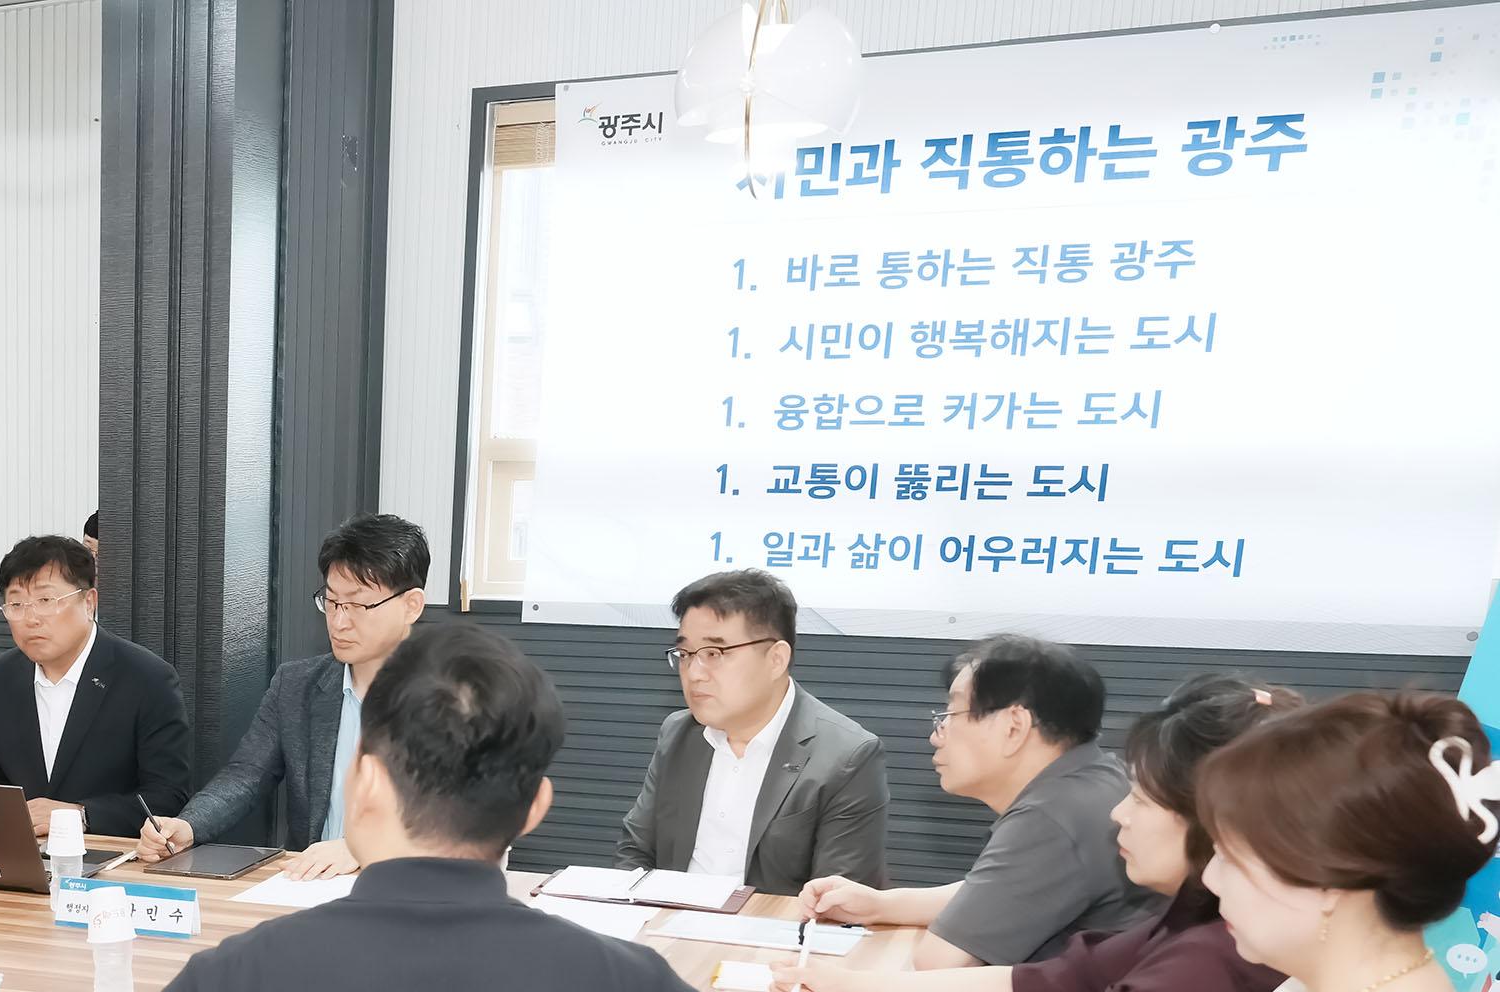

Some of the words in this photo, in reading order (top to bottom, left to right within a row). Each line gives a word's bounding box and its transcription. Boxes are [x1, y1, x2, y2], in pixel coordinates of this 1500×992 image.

[598, 111, 663, 139] 광주시
[920, 123, 1157, 190] 직통하는
[1181, 112, 1308, 177] 광주
[733, 258, 757, 291] 1.
[786, 253, 861, 291] 바로
[877, 248, 994, 289] 통하는
[1011, 243, 1093, 284] 직통
[1110, 240, 1196, 282] 광주
[728, 326, 752, 359] 1.
[779, 321, 893, 360] 시민이
[910, 315, 1114, 359] 행복해지는
[1130, 312, 1217, 353] 도시
[722, 396, 745, 428] 1.
[773, 393, 928, 432] 융합으로
[943, 391, 1062, 432] 커가는
[1077, 389, 1162, 430] 도시
[715, 463, 740, 496] 1.
[765, 462, 880, 501] 교통이
[894, 462, 1013, 502] 뚫리는
[1026, 462, 1109, 502] 도시
[710, 531, 734, 564] 1.
[762, 530, 836, 569] 일과
[847, 531, 924, 571] 삶이
[939, 533, 1146, 575] 어우러지는
[1156, 536, 1246, 578] 도시
